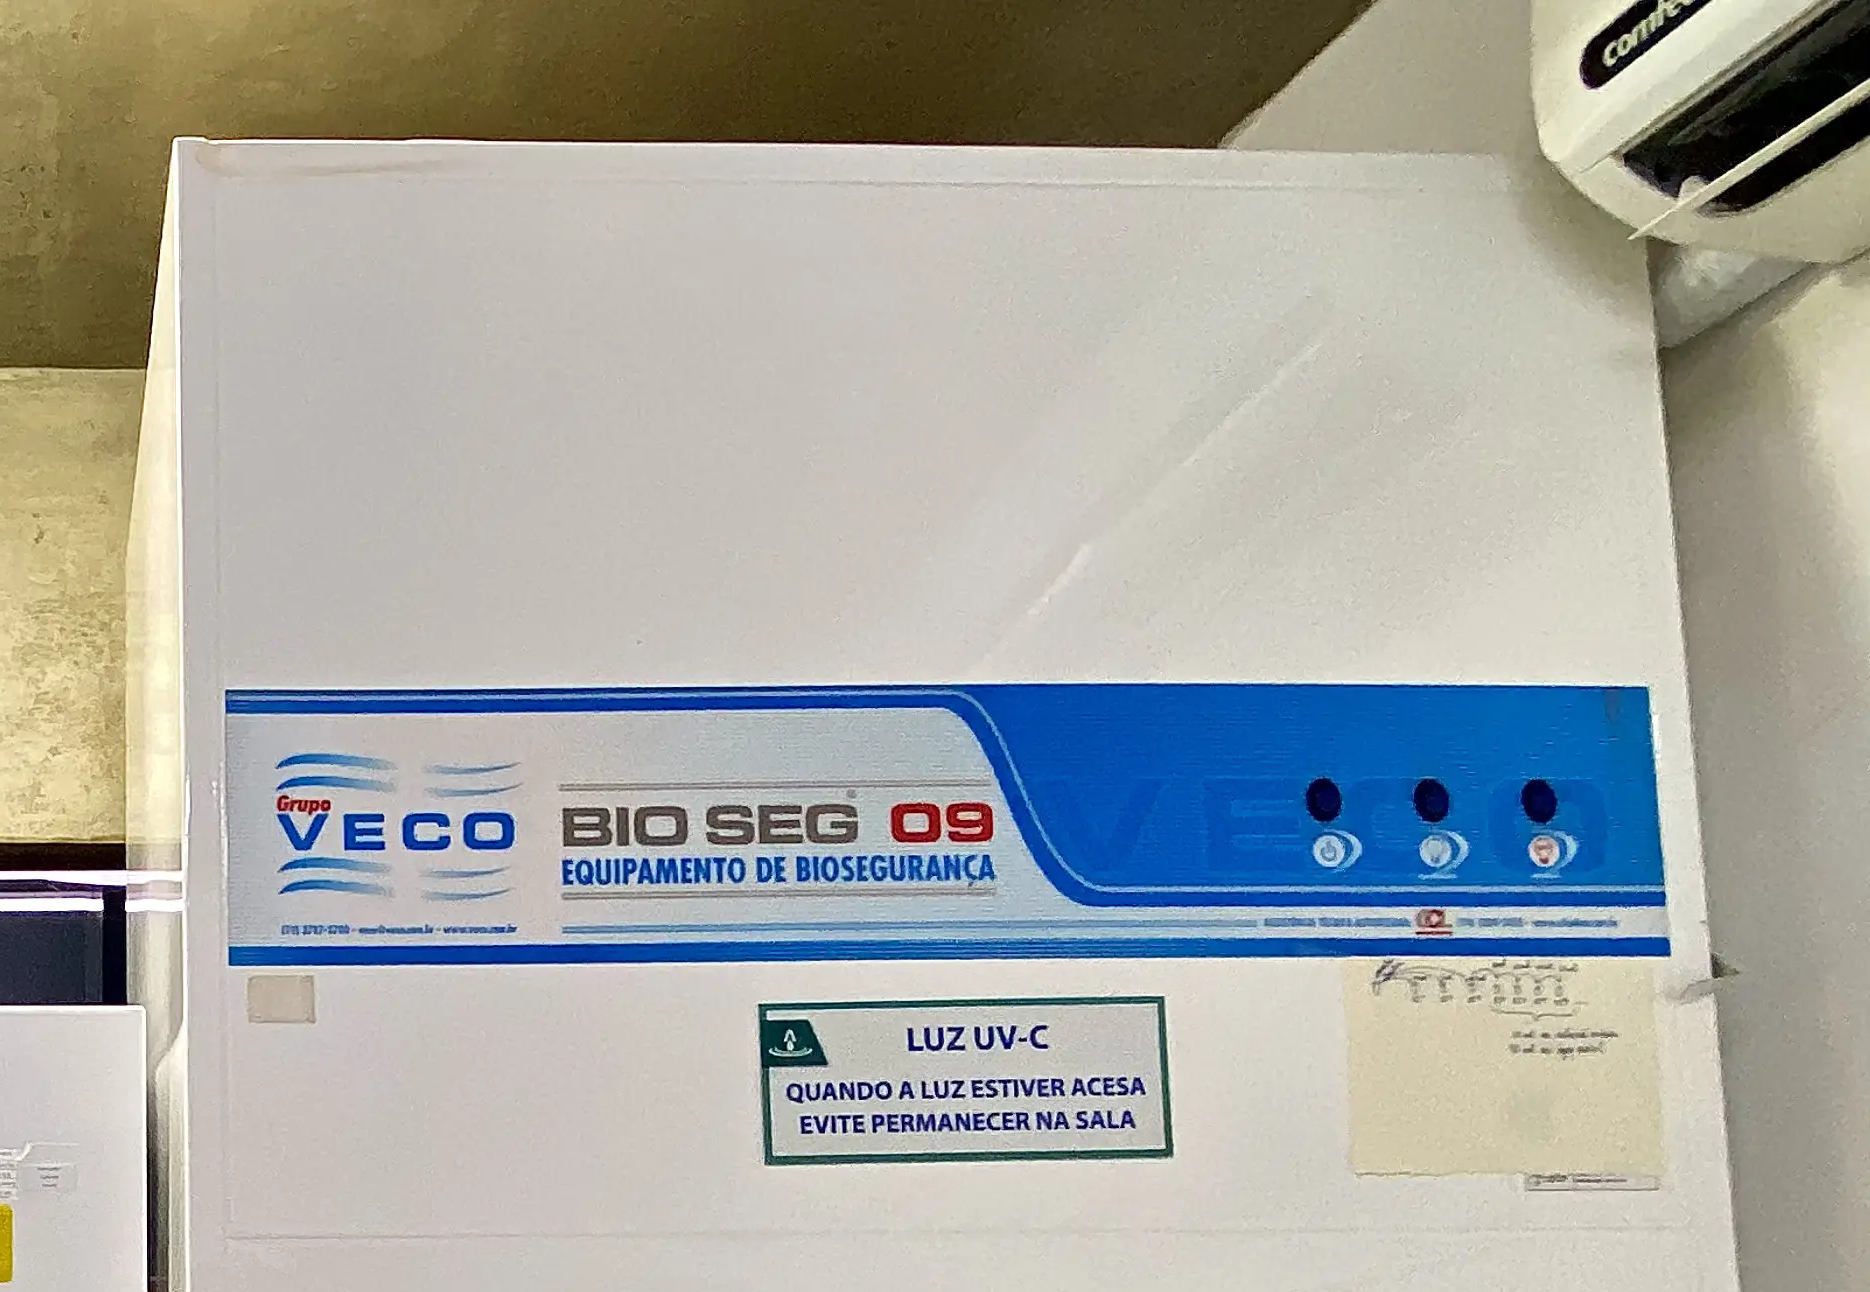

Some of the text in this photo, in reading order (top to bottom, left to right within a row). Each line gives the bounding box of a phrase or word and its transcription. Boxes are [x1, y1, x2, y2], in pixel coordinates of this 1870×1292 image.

[276, 796, 332, 815] Grupo
[278, 812, 515, 852] VECO
[561, 803, 995, 848] BIO SEG 09
[562, 853, 997, 888] EQUIPAMENTO DE BIOSEGURANÇA
[907, 1025, 1049, 1052] LUZ UV-C
[786, 1077, 1146, 1104] QUANDO A LUZ ESTIVER ACESA
[800, 1110, 1136, 1134] EVITE PERMANECER NA SALA
